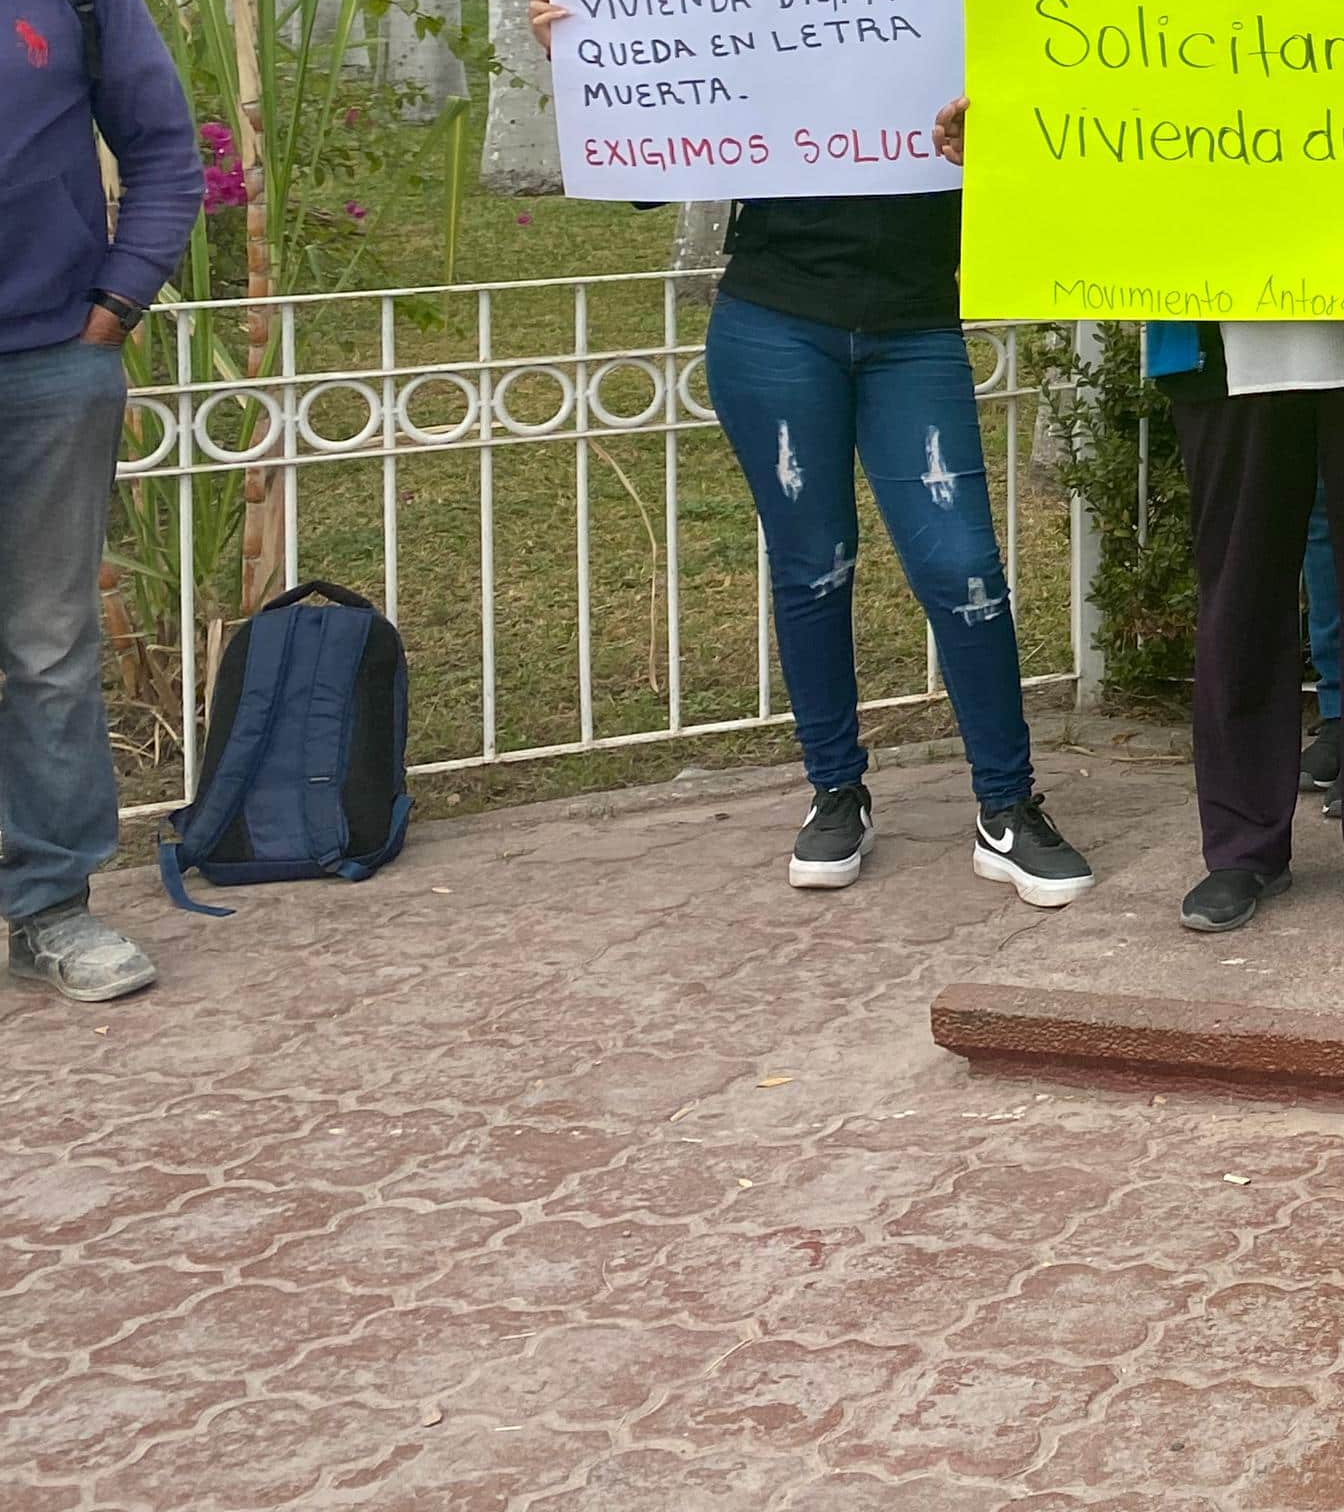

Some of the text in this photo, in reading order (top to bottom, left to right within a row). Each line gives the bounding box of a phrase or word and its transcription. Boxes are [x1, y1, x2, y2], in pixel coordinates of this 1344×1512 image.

[578, 16, 921, 67] QUEDA EN LETRA
[585, 133, 769, 171] EXIGIMOS
[1054, 279, 1232, 315] Movimiento
